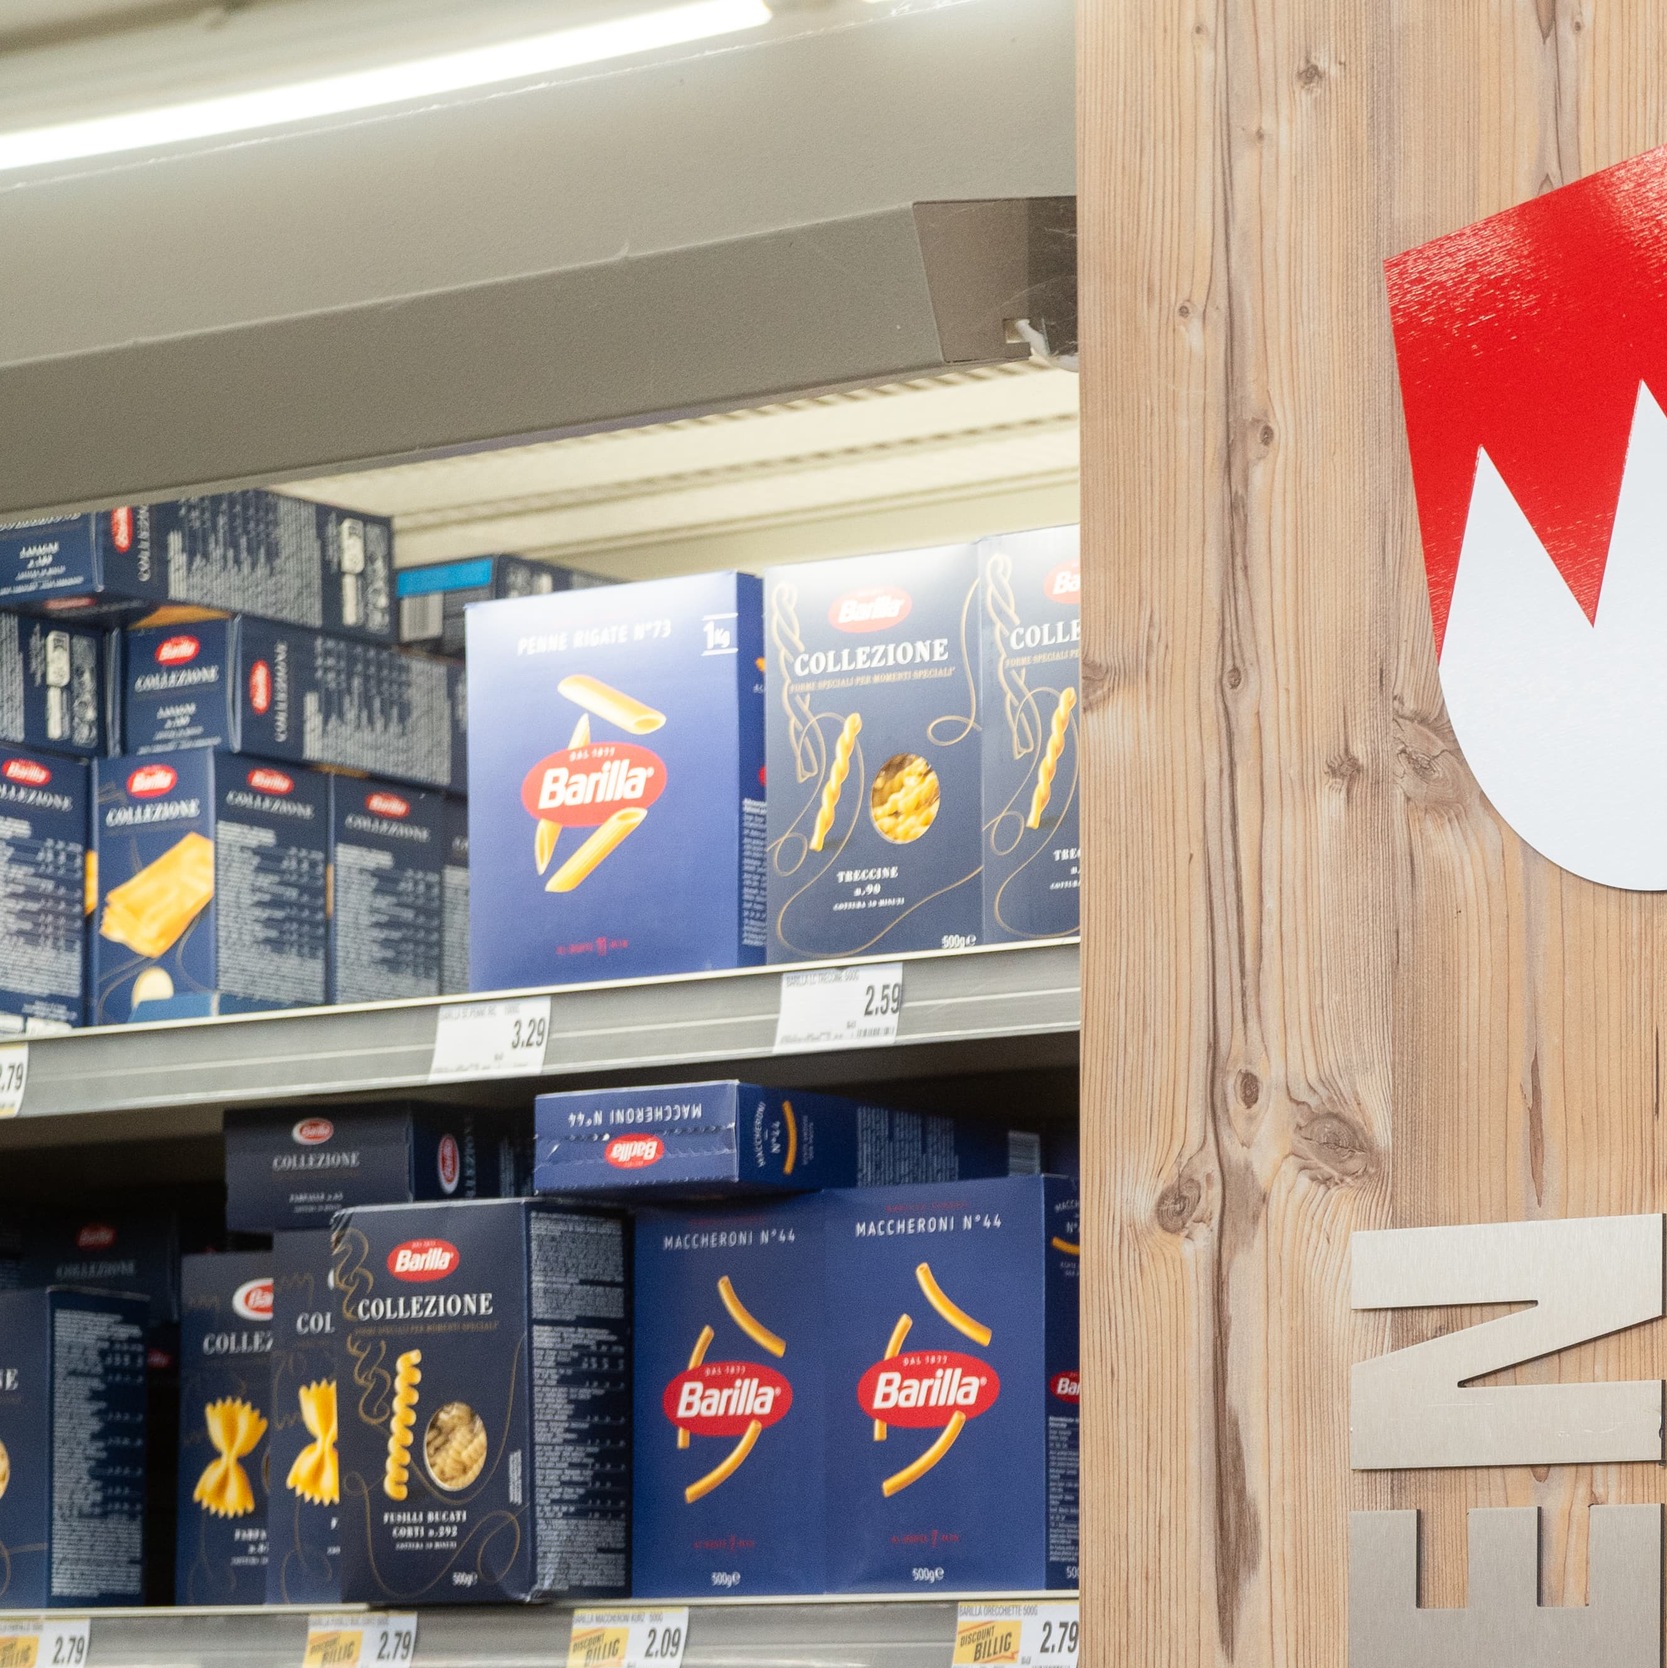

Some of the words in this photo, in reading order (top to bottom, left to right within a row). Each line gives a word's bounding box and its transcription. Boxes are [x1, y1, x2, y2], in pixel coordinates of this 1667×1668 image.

[519, 635, 568, 656] PENNE
[573, 625, 629, 649] RIGATE
[794, 638, 949, 677] COLLEZIONE
[538, 767, 654, 809] Barilla
[106, 799, 200, 826] COLLEZIONE
[838, 866, 898, 883] TRECCINE
[864, 983, 900, 1016] 2.59
[512, 1017, 545, 1048] 3.29
[610, 1104, 701, 1124] MACCHERONI
[273, 1152, 360, 1171] COLLEZIONE
[612, 1141, 657, 1162] Barilla
[663, 1230, 754, 1251] MACCHERONI
[856, 1216, 954, 1237] MACCHERONI
[394, 1246, 453, 1272] Barilla
[358, 1293, 492, 1321] COLLEZIONE
[676, 1378, 781, 1419] Barilla
[873, 1367, 986, 1410] Barilla
[384, 1511, 423, 1524] FUSILLI
[52, 1636, 85, 1664] 2.79
[377, 1631, 412, 1661] 2.79
[645, 1627, 681, 1658] 2.09
[960, 1626, 995, 1647] DISCOUNT
[974, 1632, 1012, 1662] BILLIG
[1040, 1620, 1078, 1653] 2.79
